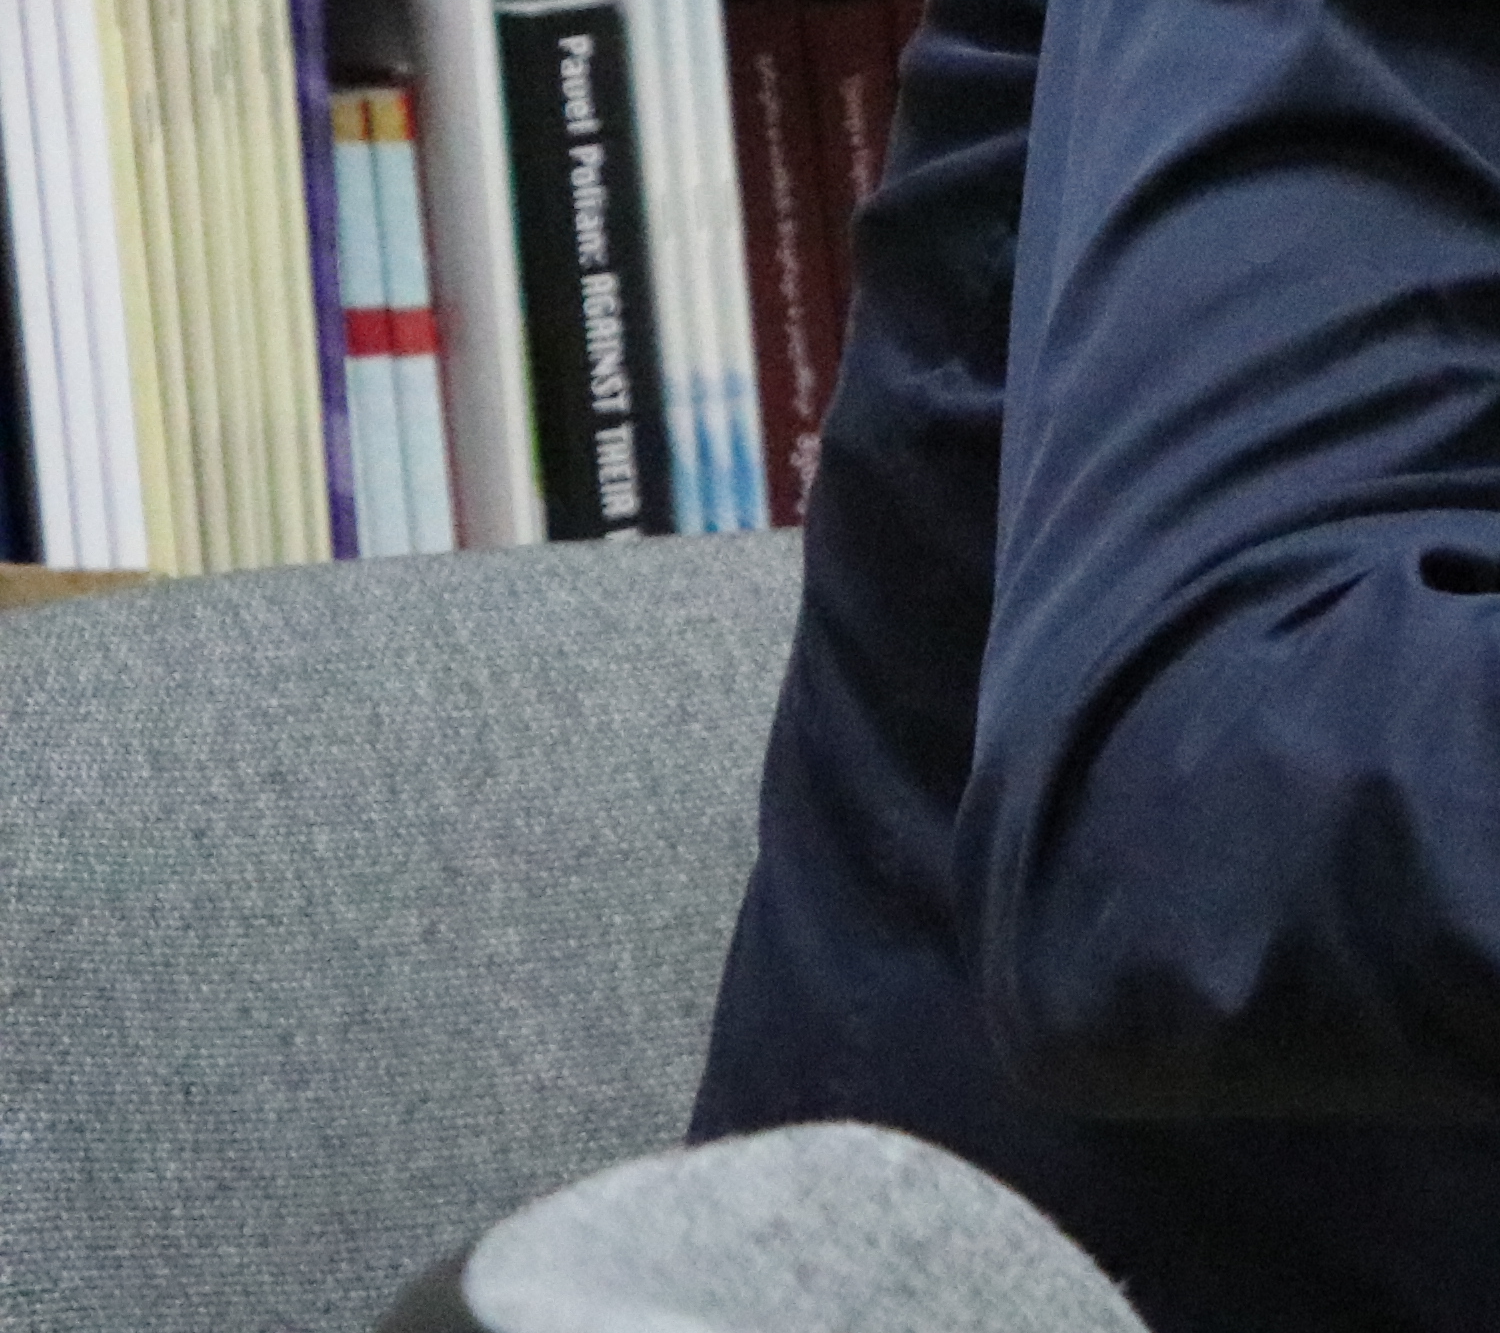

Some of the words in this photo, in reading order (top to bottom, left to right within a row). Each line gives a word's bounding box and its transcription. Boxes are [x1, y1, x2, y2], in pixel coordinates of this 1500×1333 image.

[556, 33, 602, 135] Pavel
[578, 272, 628, 413] AGAINST
[592, 421, 637, 520] THEIR
